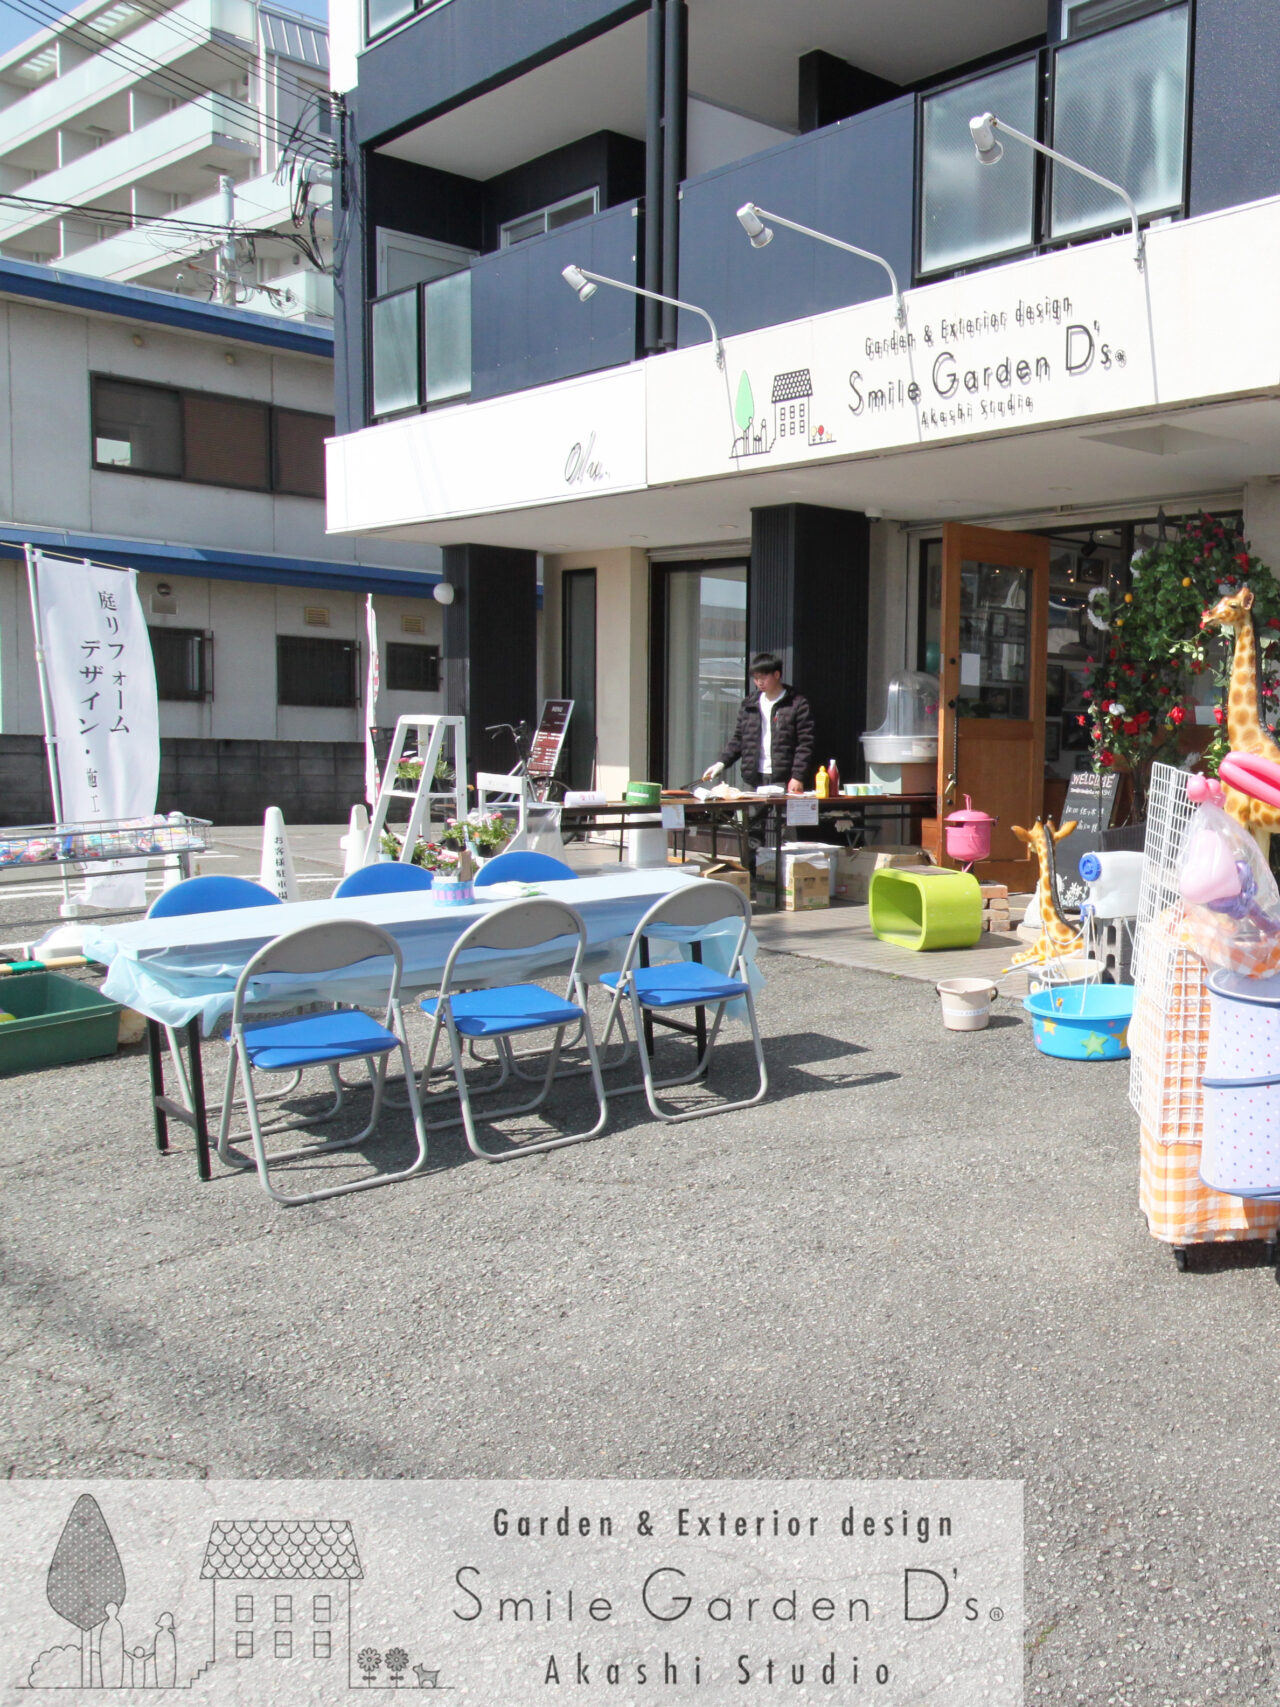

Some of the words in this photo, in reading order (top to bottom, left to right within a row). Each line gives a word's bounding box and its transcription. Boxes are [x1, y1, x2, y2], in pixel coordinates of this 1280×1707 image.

[865, 330, 914, 357] Garden
[923, 324, 932, 343] &
[941, 310, 1006, 340] Exterior
[1015, 296, 1070, 323] design
[849, 370, 920, 413] Smile
[932, 351, 1049, 395] Garden
[921, 404, 972, 426] Akashi
[981, 394, 1033, 417] Studio
[98, 590, 130, 734] 庭リフォーム
